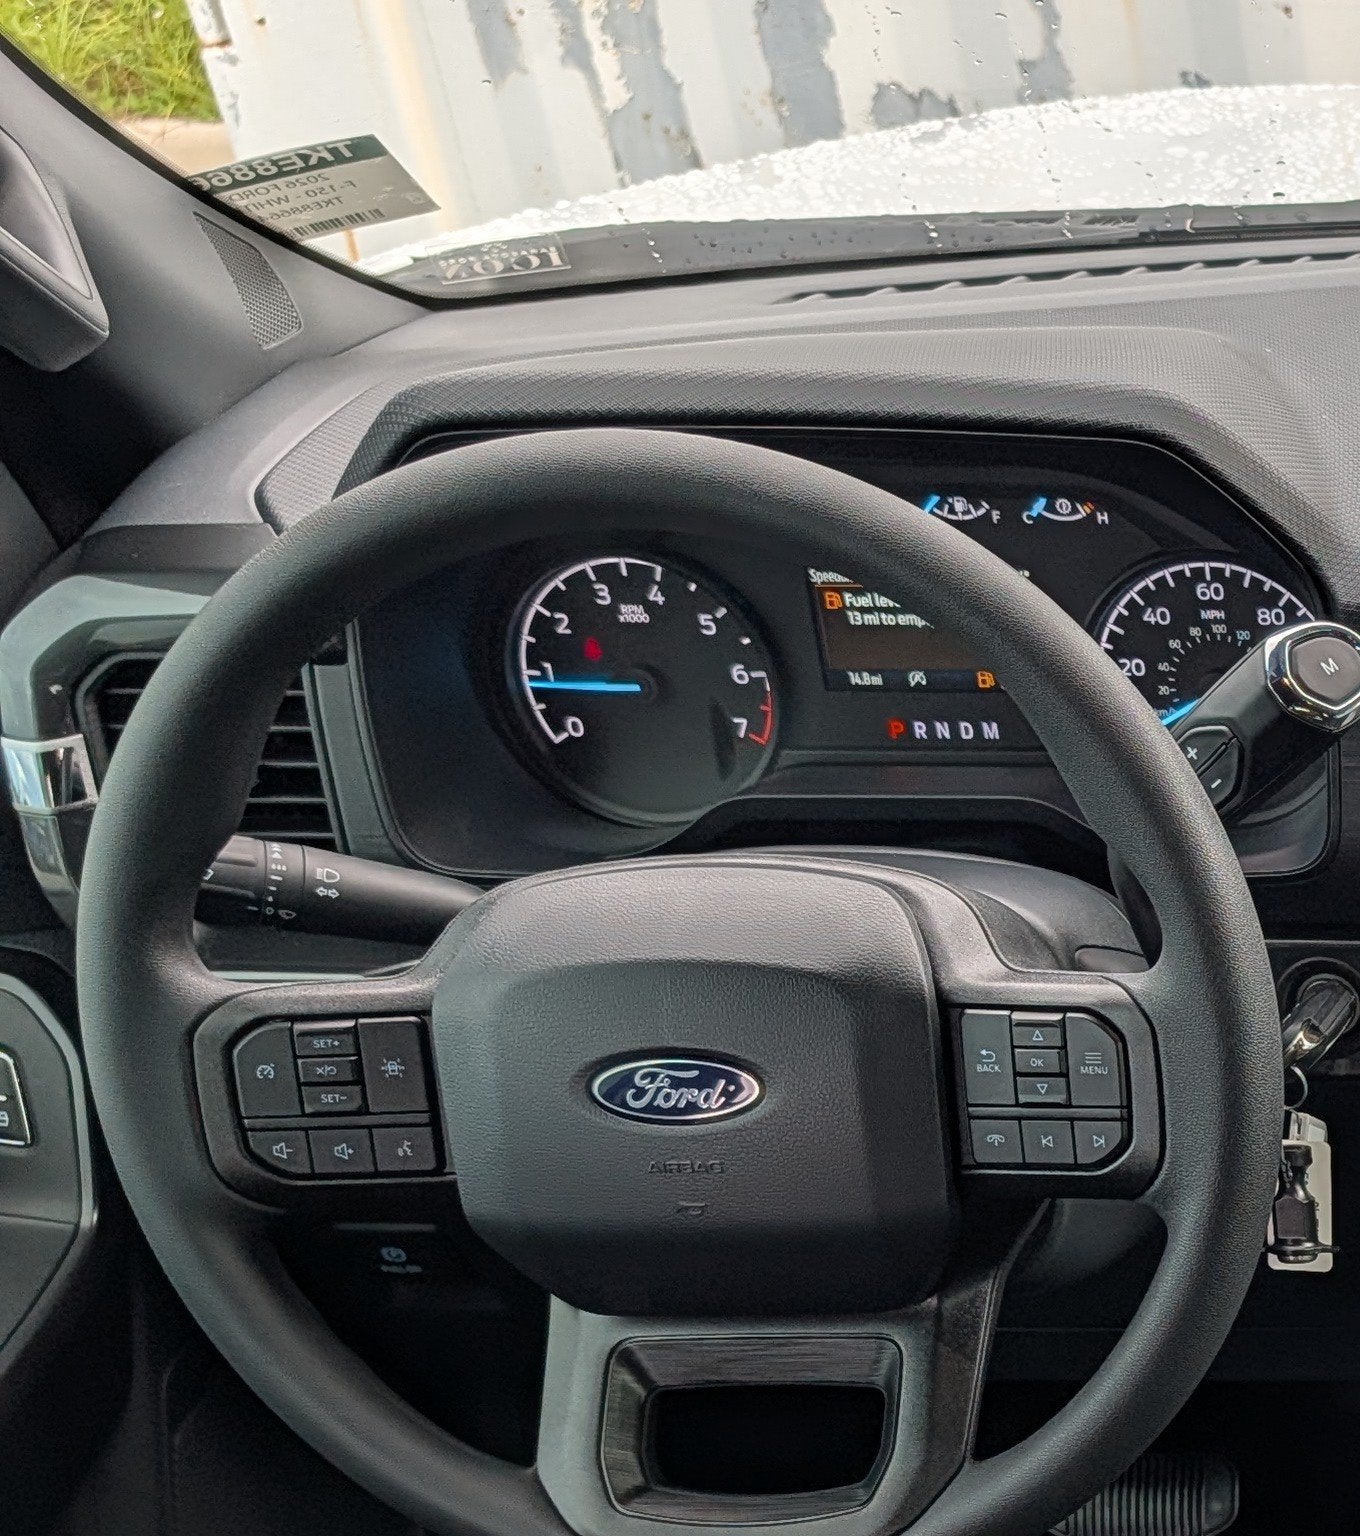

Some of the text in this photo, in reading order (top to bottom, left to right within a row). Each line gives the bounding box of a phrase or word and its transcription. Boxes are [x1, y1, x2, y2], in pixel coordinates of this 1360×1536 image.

[991, 510, 1001, 524] F
[1021, 511, 1034, 525] C
[1096, 511, 1109, 525] H
[593, 582, 612, 606] 3
[647, 584, 666, 606] 4
[1195, 583, 1225, 602] 60
[843, 592, 873, 609] Fuel
[619, 603, 645, 614] RPM
[1200, 610, 1226, 621] MPH
[553, 612, 572, 634] 2
[698, 613, 717, 635] 5
[846, 611, 862, 626] 13
[863, 611, 879, 626] mi
[881, 612, 896, 626] to
[1142, 607, 1171, 626] 40
[1257, 608, 1286, 626] 80
[1189, 627, 1202, 638] 80
[1211, 624, 1227, 635] 100
[1236, 630, 1250, 641] 120
[1168, 639, 1182, 650] 60
[540, 661, 554, 682] 1
[731, 663, 750, 685] 6
[1118, 658, 1146, 678] 20
[1157, 662, 1171, 673] 40
[1320, 657, 1340, 677] M
[870, 673, 884, 687] mi
[1157, 685, 1170, 696] 20
[565, 716, 585, 738] 0
[731, 717, 748, 738] 7
[887, 719, 1000, 740] P R N D M
[313, 1038, 340, 1049] SET+
[976, 1064, 1001, 1073] BACK
[1030, 1058, 1044, 1067] OK
[1080, 1066, 1108, 1075] MENU
[626, 1067, 727, 1109] Ford
[648, 1160, 726, 1175] AIRBAG
